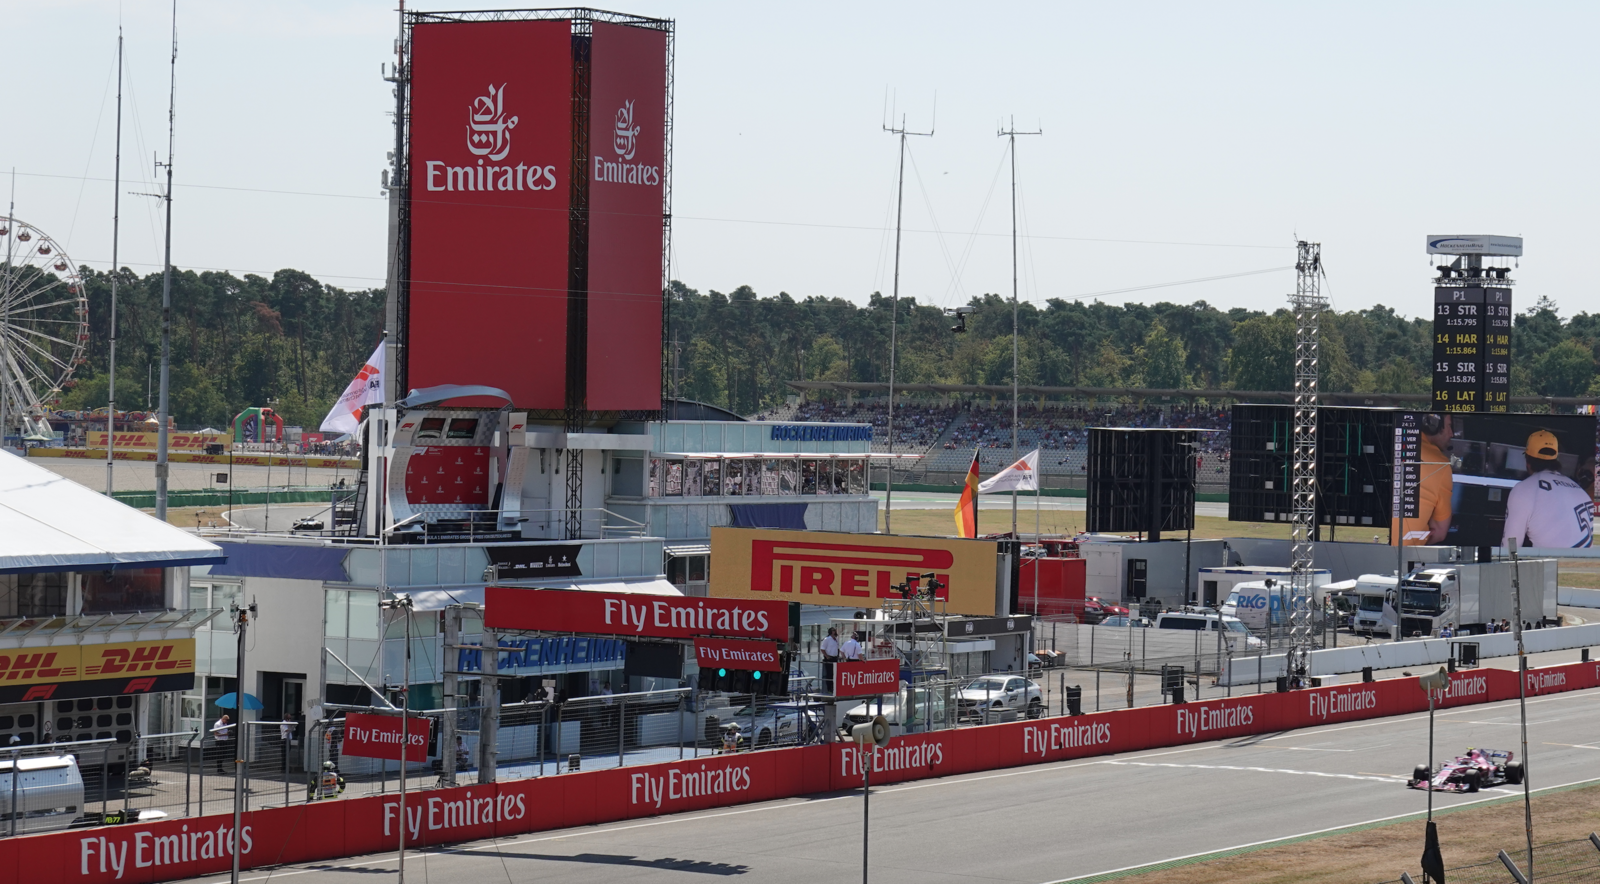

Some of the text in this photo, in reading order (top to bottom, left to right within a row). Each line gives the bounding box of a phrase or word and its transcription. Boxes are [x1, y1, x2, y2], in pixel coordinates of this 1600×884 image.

[425, 158, 557, 191] Emirates
[594, 156, 659, 186] Emirates
[1453, 291, 1466, 300] P1
[1496, 292, 1503, 302] P1
[1438, 305, 1477, 315] 13 STR
[1487, 306, 1509, 316] 13 STR
[1436, 334, 1477, 344] 14 HAR
[1486, 334, 1509, 345] 14 HAR
[1436, 362, 1476, 372] 15 SIR
[1486, 363, 1507, 373] 15 SIR
[1436, 390, 1476, 400] 16 LAT
[1485, 392, 1507, 401] 16 LAT
[99, 434, 148, 446] DHL
[771, 425, 873, 441] HOCKENHEIMRING
[172, 436, 218, 448] DHL
[1237, 594, 1266, 609] RKG
[604, 599, 769, 632] Fly Emirates
[100, 645, 178, 674] DHL
[699, 646, 774, 663] Fly Emirates
[841, 671, 895, 689] Fly Emirates
[1446, 674, 1487, 698] Emirates
[1540, 671, 1566, 688] Emirates
[1309, 688, 1376, 720] Fly Emirates
[1177, 703, 1253, 738] Fly Emirates
[349, 726, 369, 744] Fly
[1024, 720, 1111, 756] Fly Emirates
[874, 740, 942, 772] Emirates
[631, 764, 750, 808] Fly Emirates
[383, 791, 526, 840] Fy Emirates
[80, 824, 252, 880] Fly Emirates
